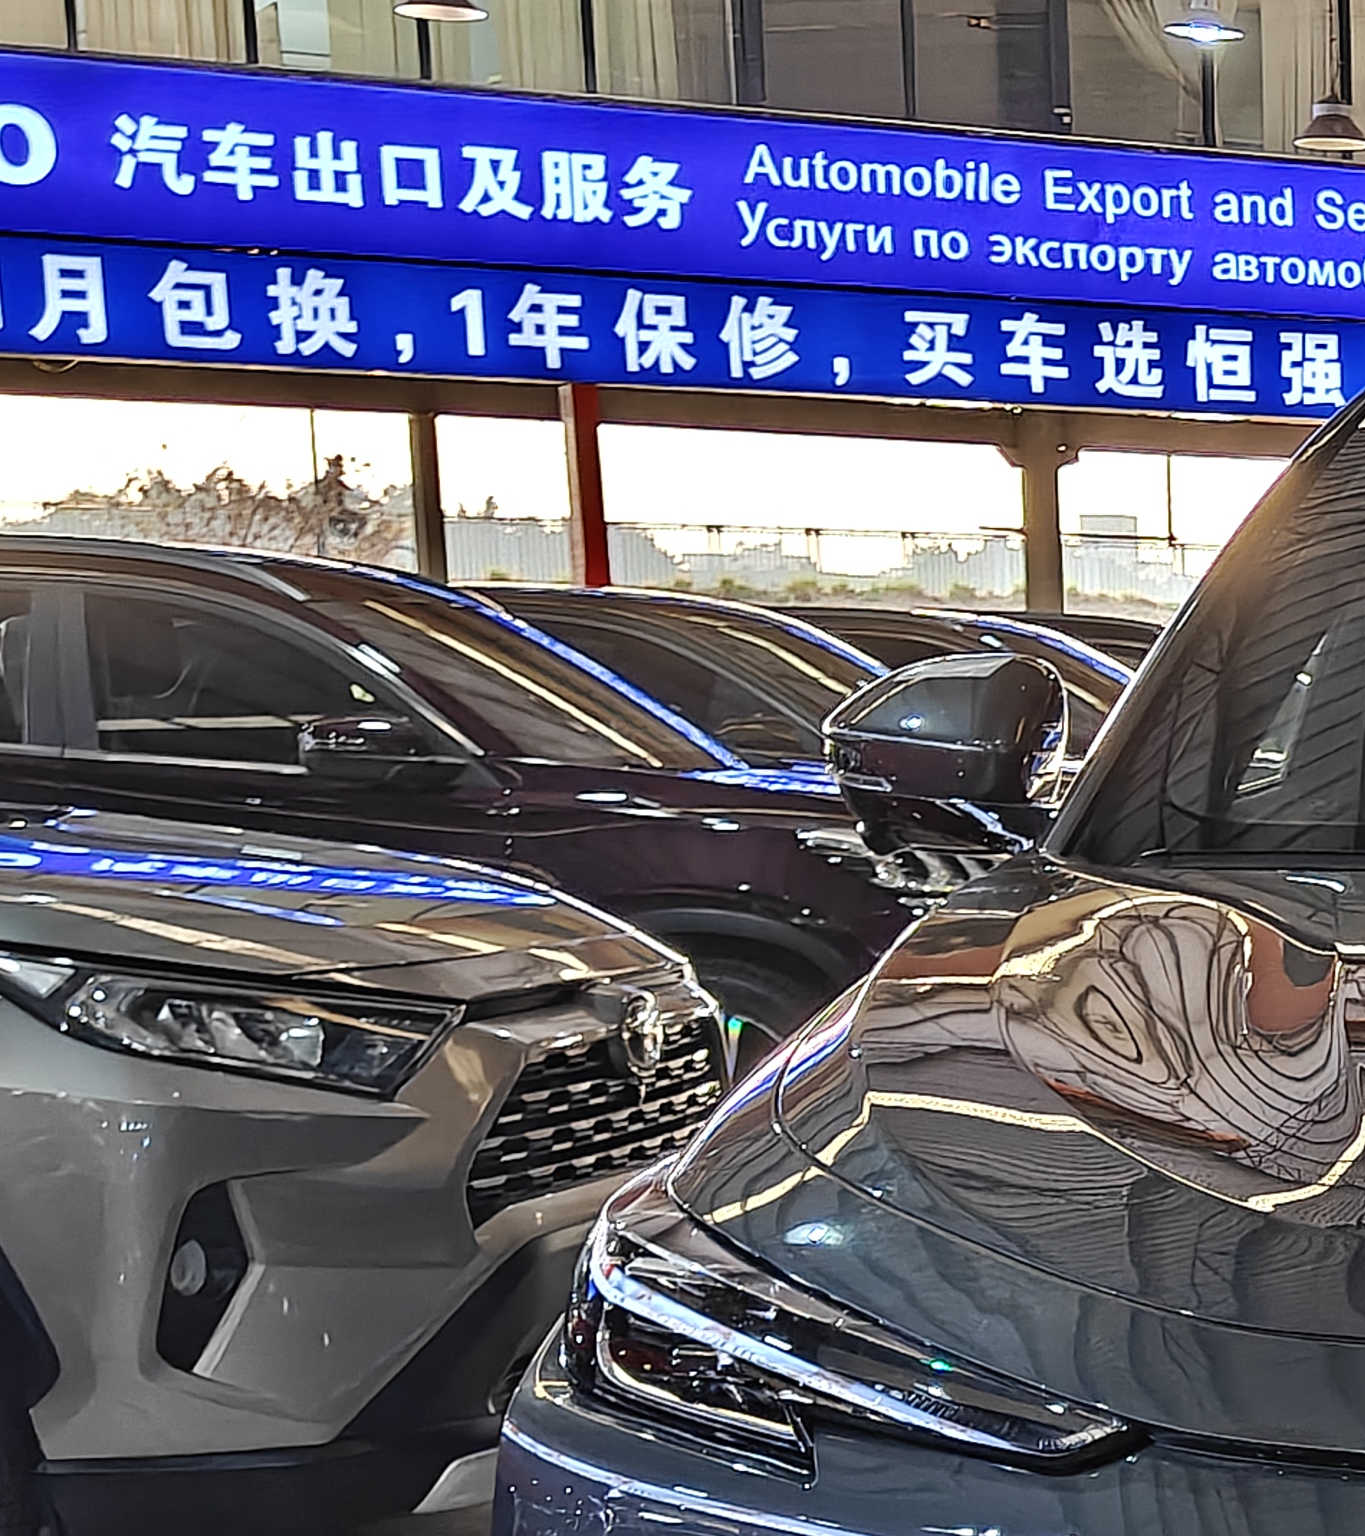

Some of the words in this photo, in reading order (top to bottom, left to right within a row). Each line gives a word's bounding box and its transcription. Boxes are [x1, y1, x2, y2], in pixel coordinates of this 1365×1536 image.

[109, 112, 694, 230] 汽车出口及服务
[743, 144, 1022, 205] Automobile
[1043, 168, 1195, 224] Export
[1213, 187, 1294, 227] and
[736, 199, 894, 261] Услуги
[913, 228, 970, 261] по
[988, 234, 1192, 286] экспорту
